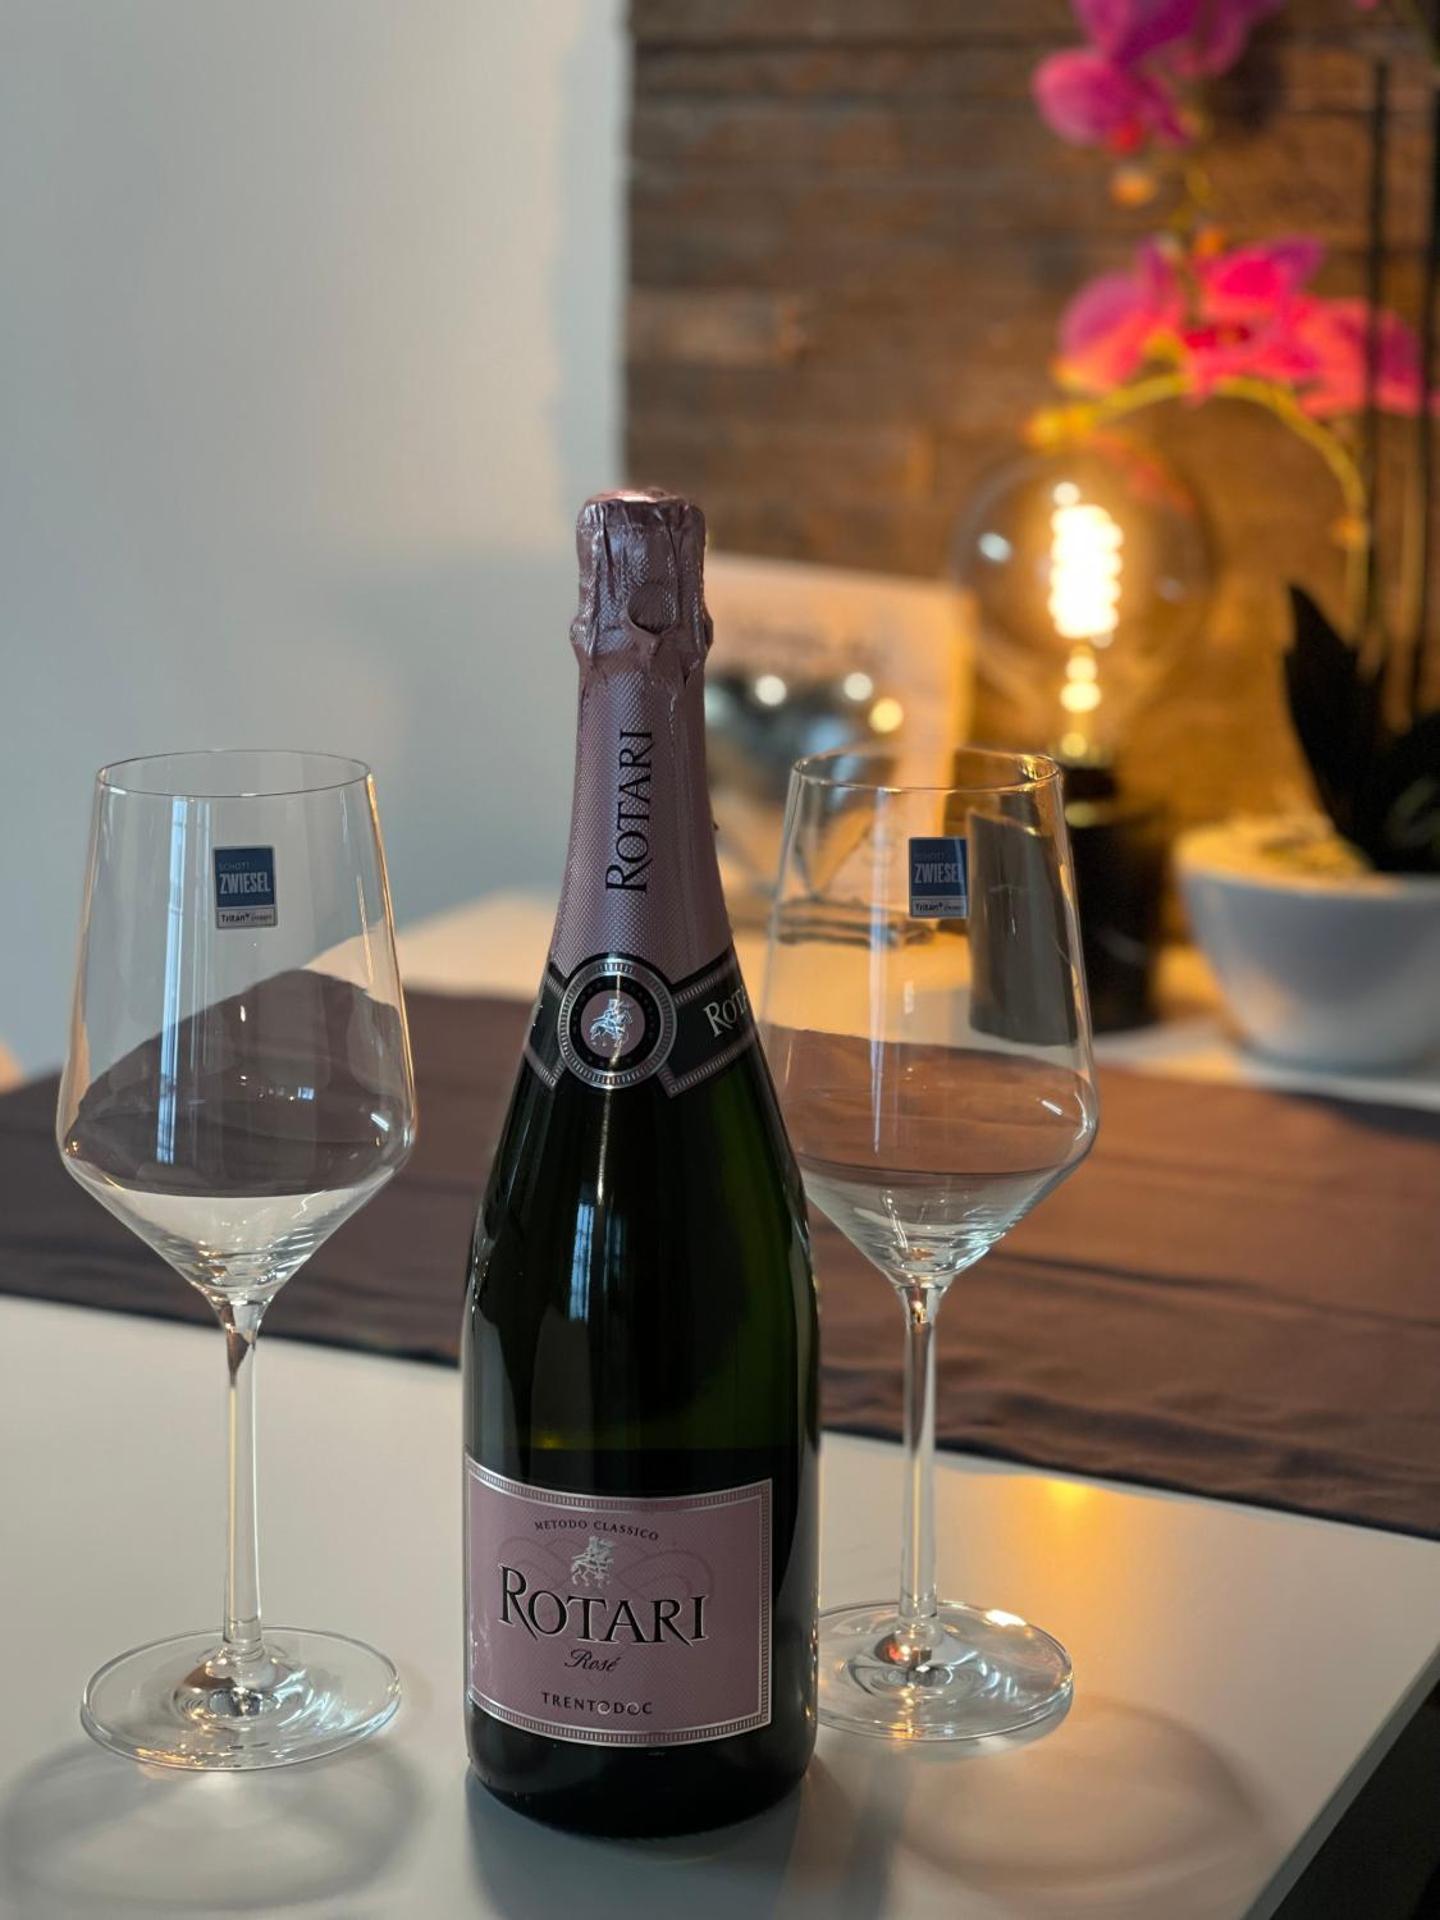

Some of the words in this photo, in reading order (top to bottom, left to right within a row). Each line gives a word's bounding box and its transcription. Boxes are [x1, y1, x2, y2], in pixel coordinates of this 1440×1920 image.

[606, 730, 653, 894] ROTARI
[219, 871, 271, 895] ZWIESEL
[535, 1519, 588, 1530] METODO
[593, 1520, 659, 1541] CLASSICO
[498, 1563, 710, 1646] ROTARI
[564, 1648, 621, 1672] Rosé
[542, 1692, 652, 1715] TRENTODOC
